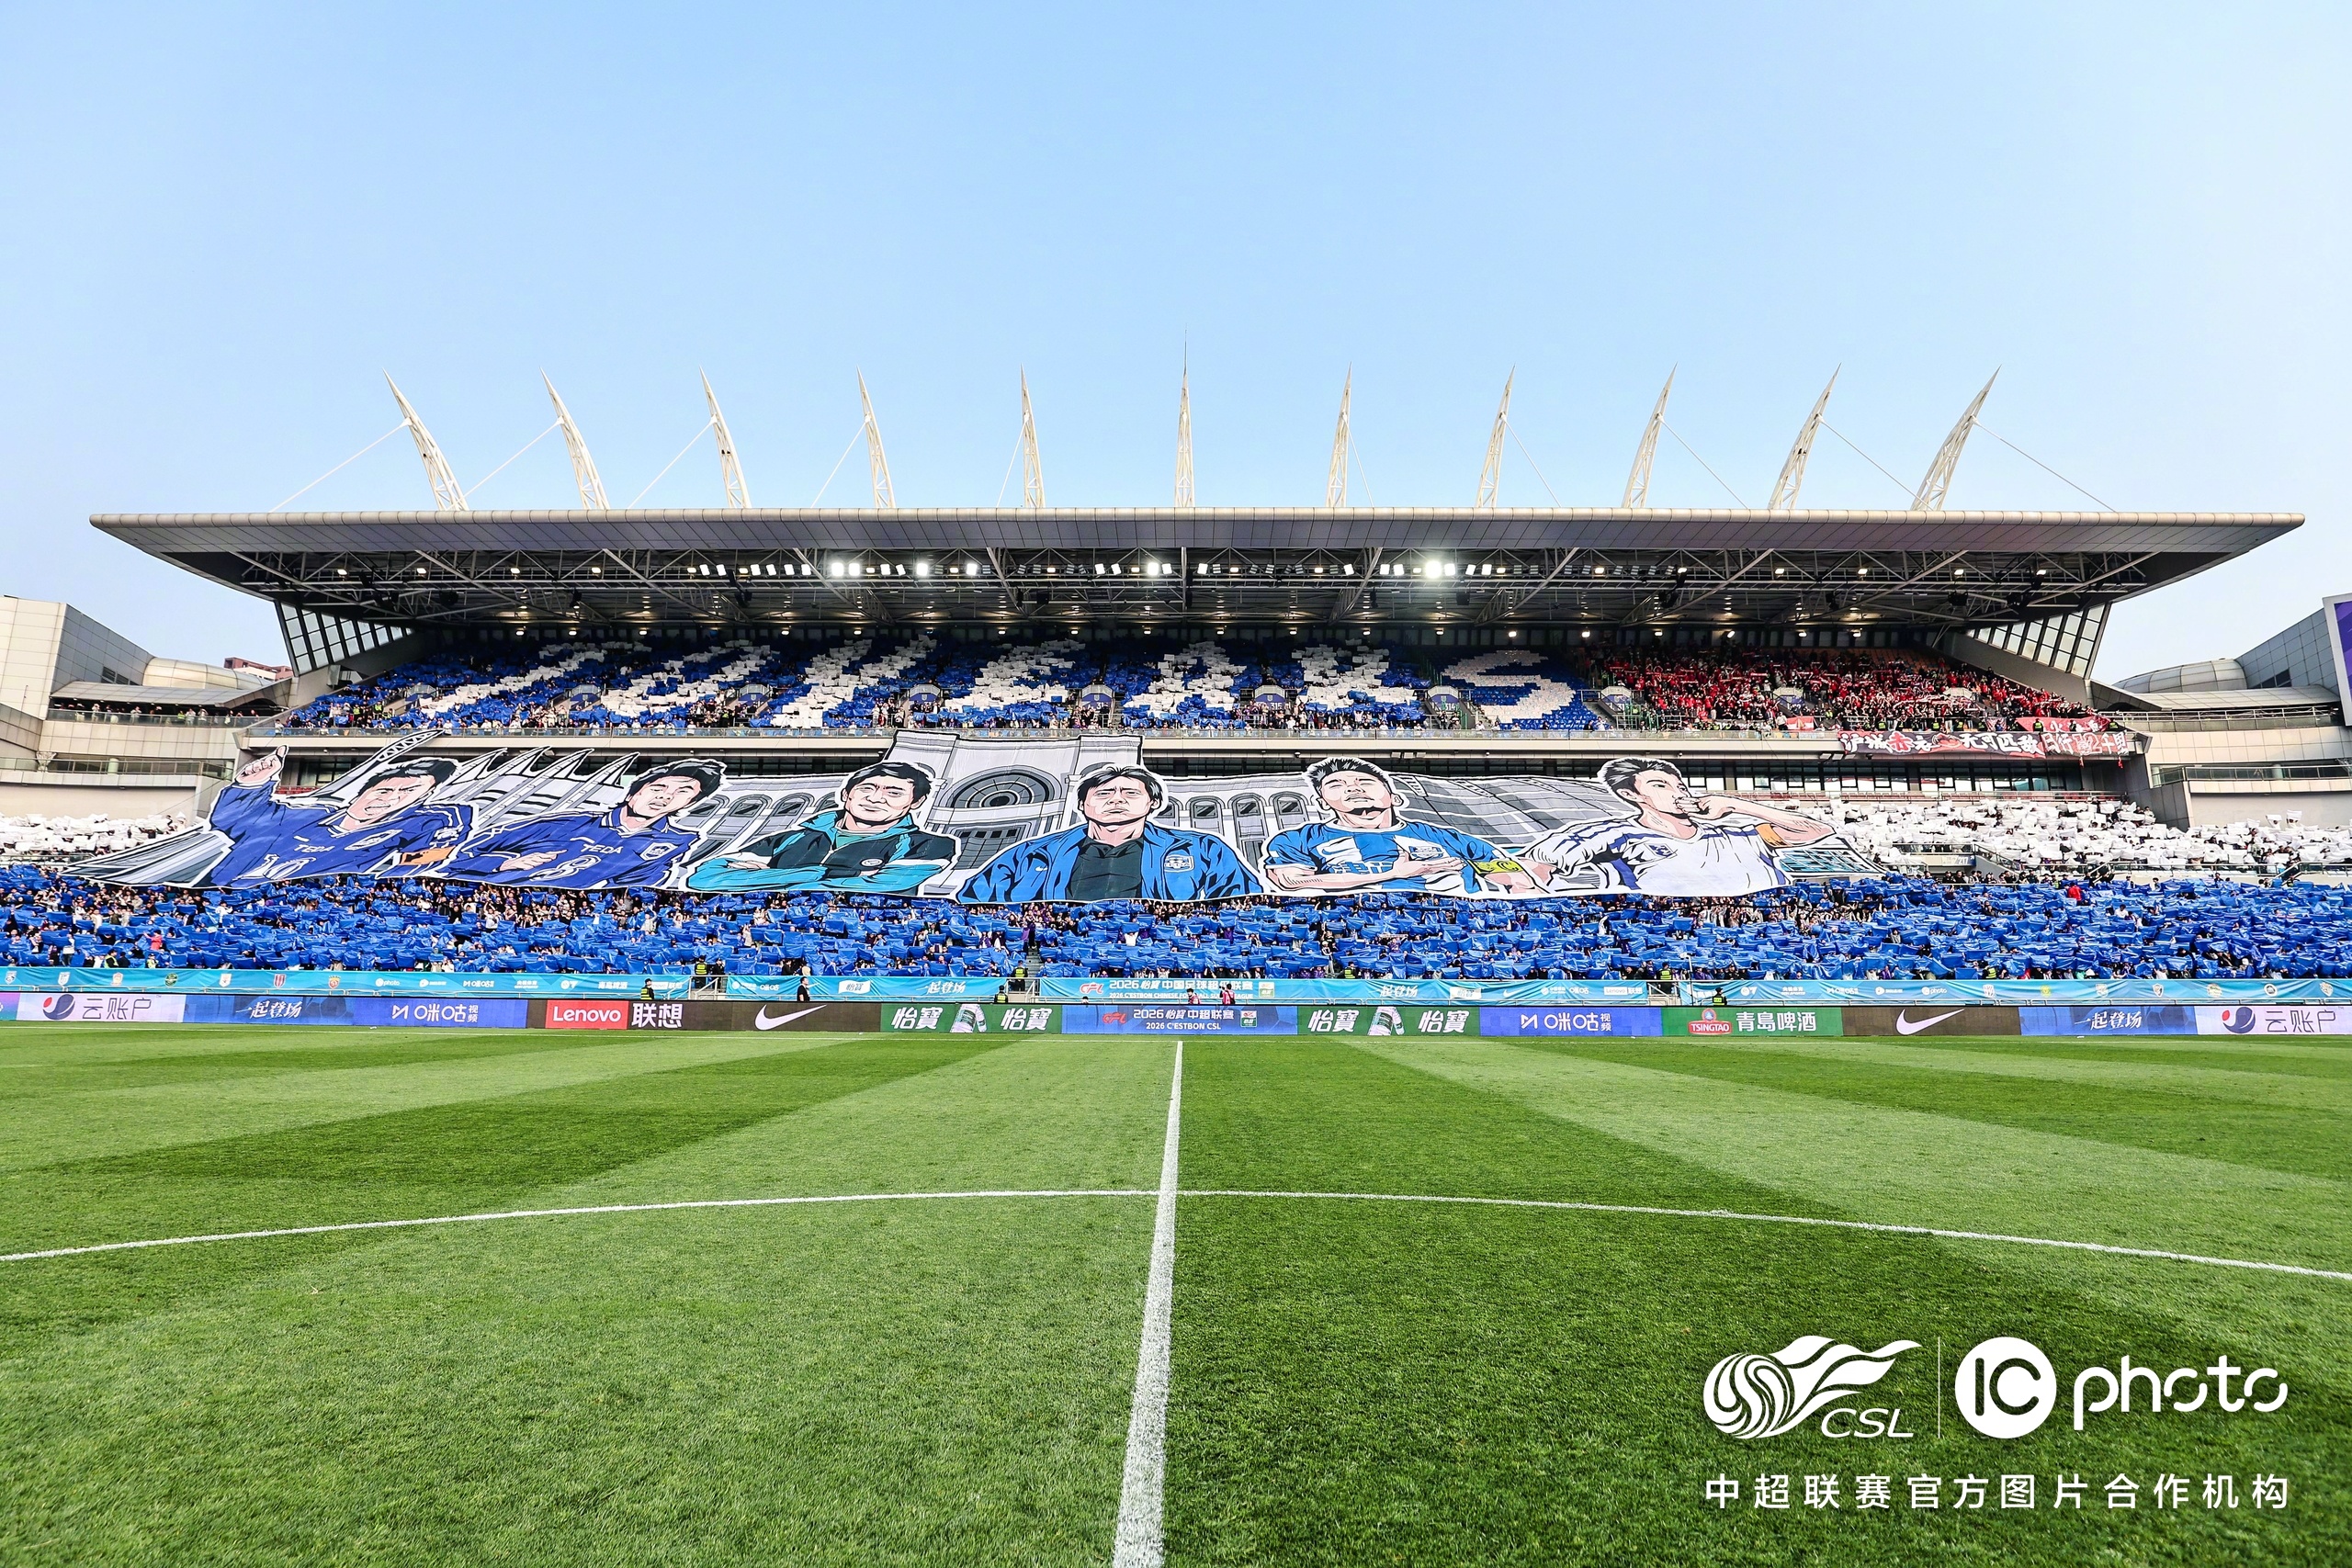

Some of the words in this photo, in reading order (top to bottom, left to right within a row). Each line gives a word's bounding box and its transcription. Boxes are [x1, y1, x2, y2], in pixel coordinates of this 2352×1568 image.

[1272, 701, 1282, 710] 315
[294, 843, 335, 853] TEDA
[581, 843, 624, 854] TEDA
[1958, 856, 1968, 865] 217
[1109, 979, 1139, 990] 2026
[82, 997, 153, 1021] 云账户
[236, 1000, 304, 1020] 一起登场
[553, 1006, 622, 1023] Lenovo
[630, 1002, 684, 1029] 联想
[890, 1007, 944, 1031] 怡寶
[1133, 1010, 1164, 1019] 2026
[1187, 1009, 1235, 1020] 中超联赛
[1000, 1008, 1054, 1032] 怡寶
[1307, 1009, 1360, 1032] 怡寶
[1419, 1010, 1470, 1033] 怡寶
[1690, 1023, 1730, 1032] TSINGTAO
[2075, 1010, 2143, 1031] 一起登场
[2265, 1009, 2336, 1032] 云账户
